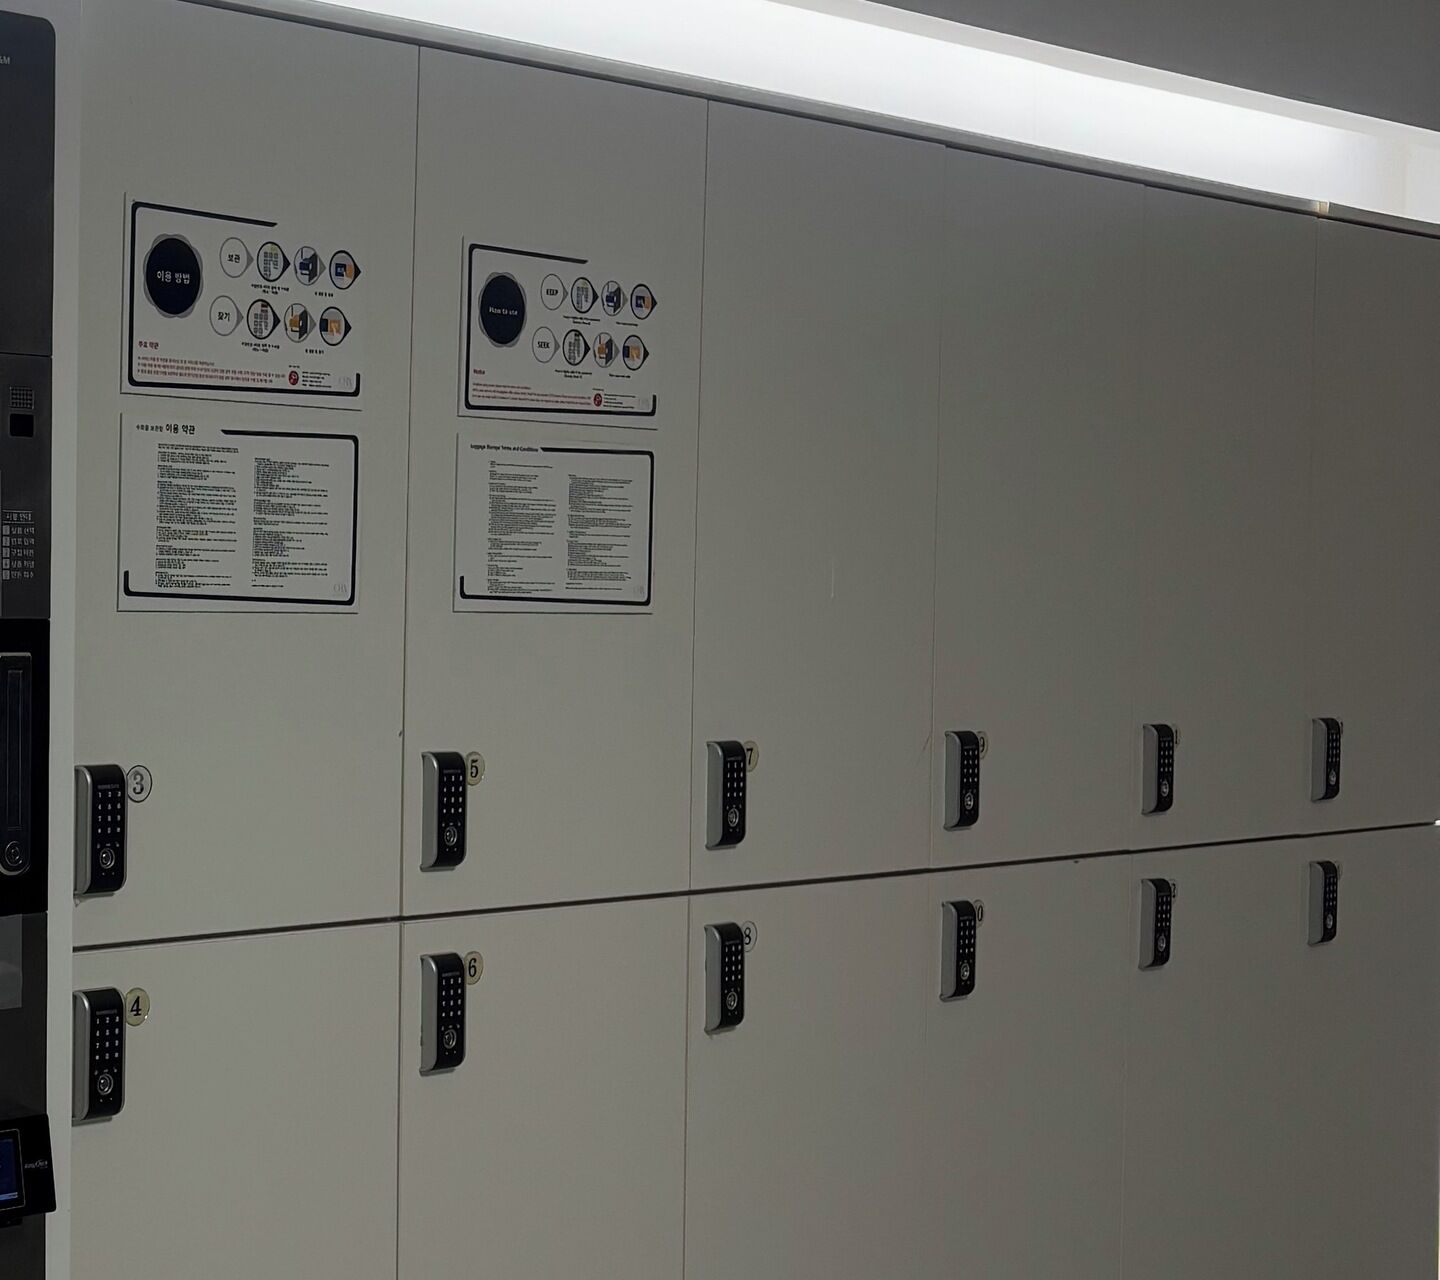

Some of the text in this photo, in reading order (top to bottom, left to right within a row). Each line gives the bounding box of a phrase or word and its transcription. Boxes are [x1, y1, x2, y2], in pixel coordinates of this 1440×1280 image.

[227, 254, 241, 264] 보관
[156, 270, 190, 285] 이용 방법
[217, 311, 231, 322] 찾기
[164, 423, 178, 434] 이용
[181, 425, 195, 435] 약관
[746, 748, 754, 765] 7
[470, 759, 479, 778] 5
[132, 770, 145, 795] 3
[744, 927, 752, 945] 8
[468, 958, 477, 978] 6
[130, 995, 142, 1017] 4
